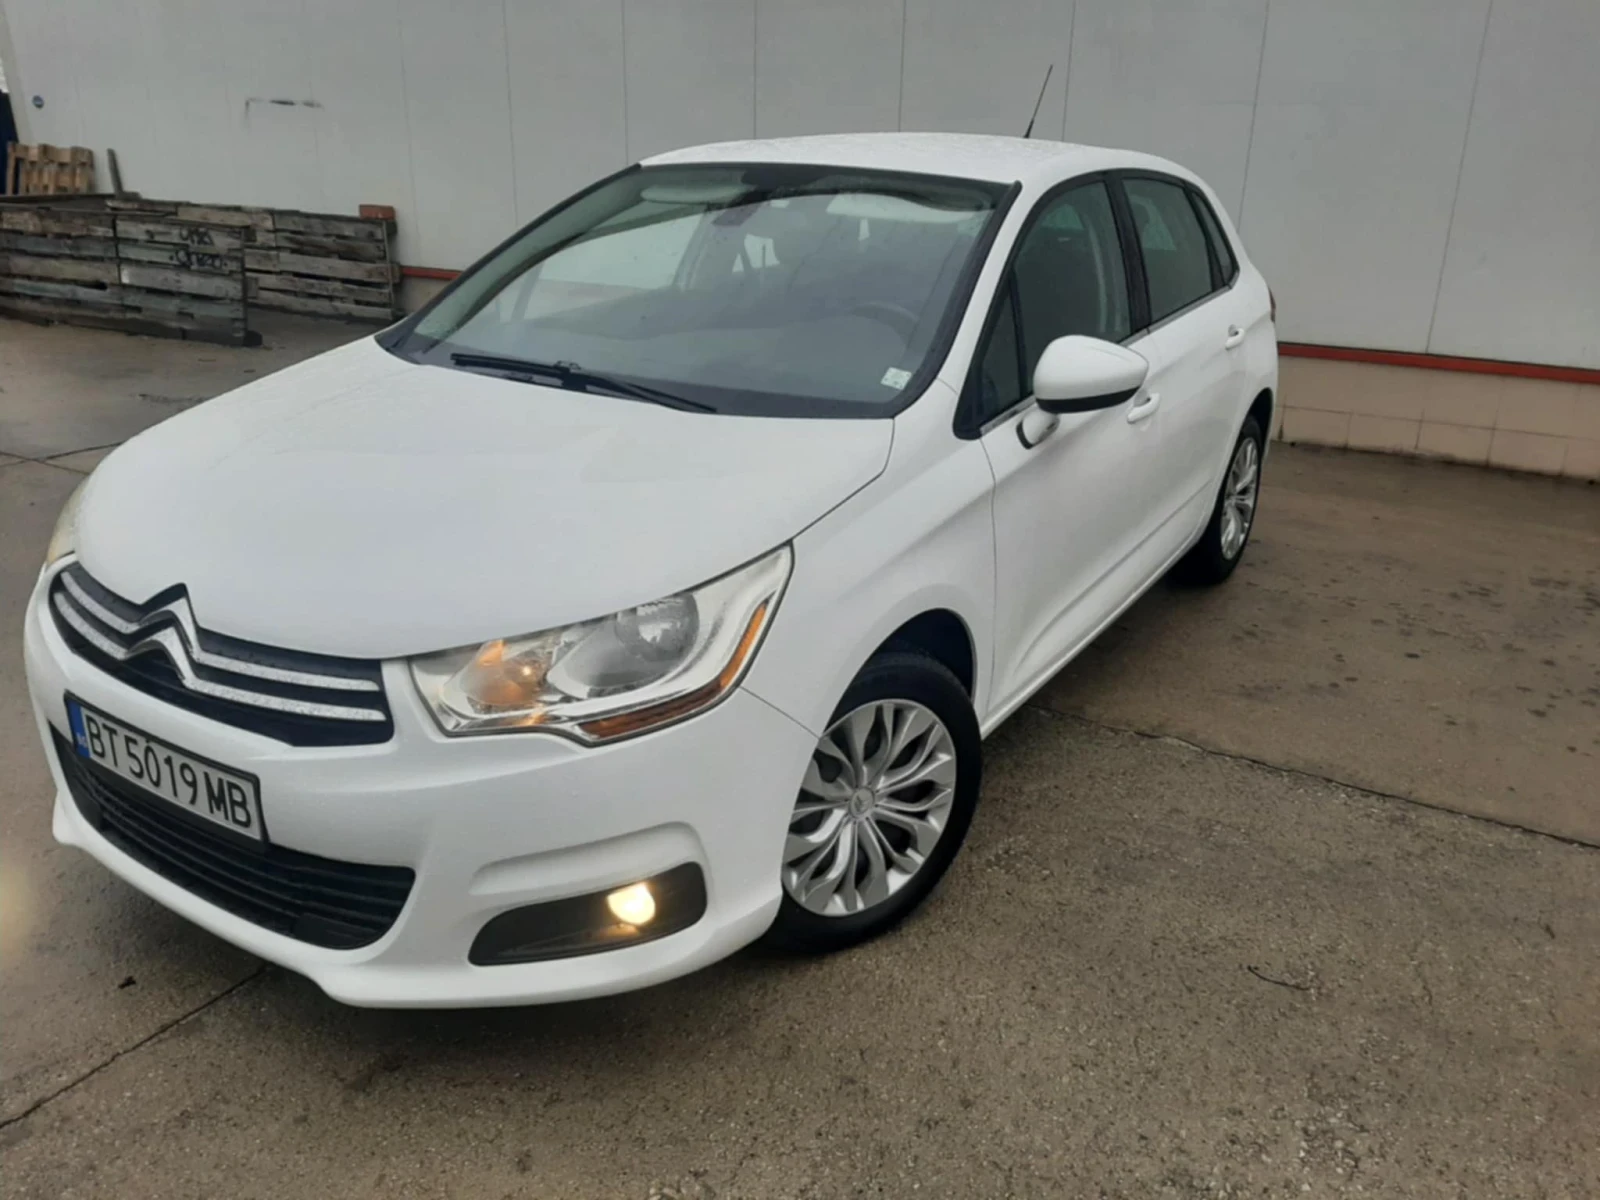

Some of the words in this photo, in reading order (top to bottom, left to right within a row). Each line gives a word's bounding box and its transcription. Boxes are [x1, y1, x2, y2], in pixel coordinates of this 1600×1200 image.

[85, 714, 118, 767] BT
[124, 735, 198, 805] 5019
[204, 770, 251, 828] MB
